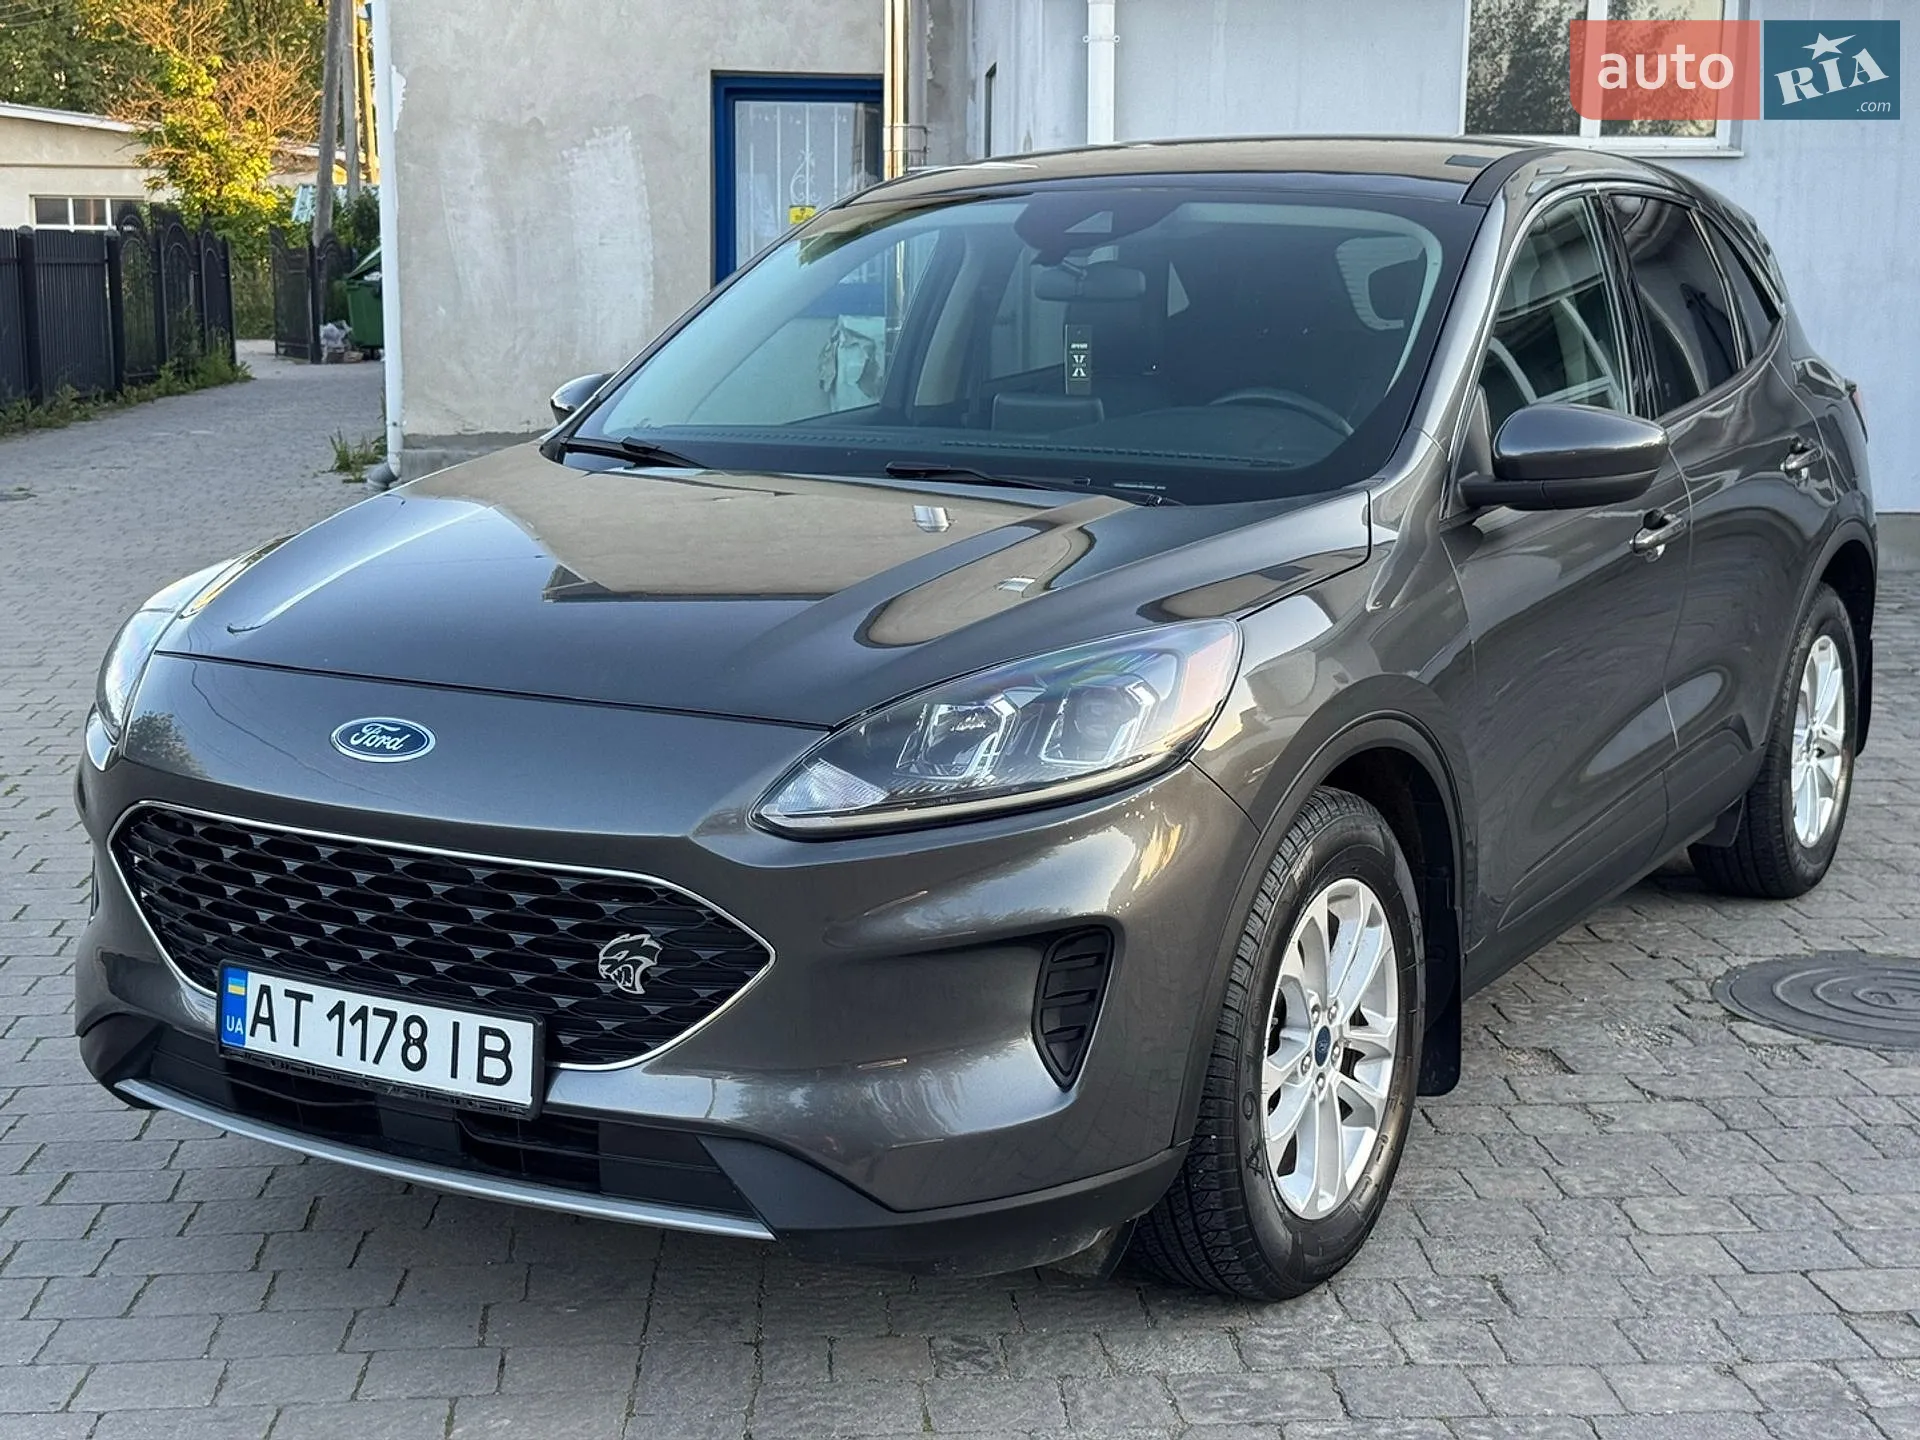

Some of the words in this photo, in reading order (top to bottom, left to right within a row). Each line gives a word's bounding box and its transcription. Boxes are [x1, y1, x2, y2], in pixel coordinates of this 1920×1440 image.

[350, 722, 411, 750] Ford
[226, 1015, 244, 1035] UA
[249, 984, 314, 1047] AT
[326, 1000, 428, 1072] 1178
[449, 1021, 513, 1087] IB
